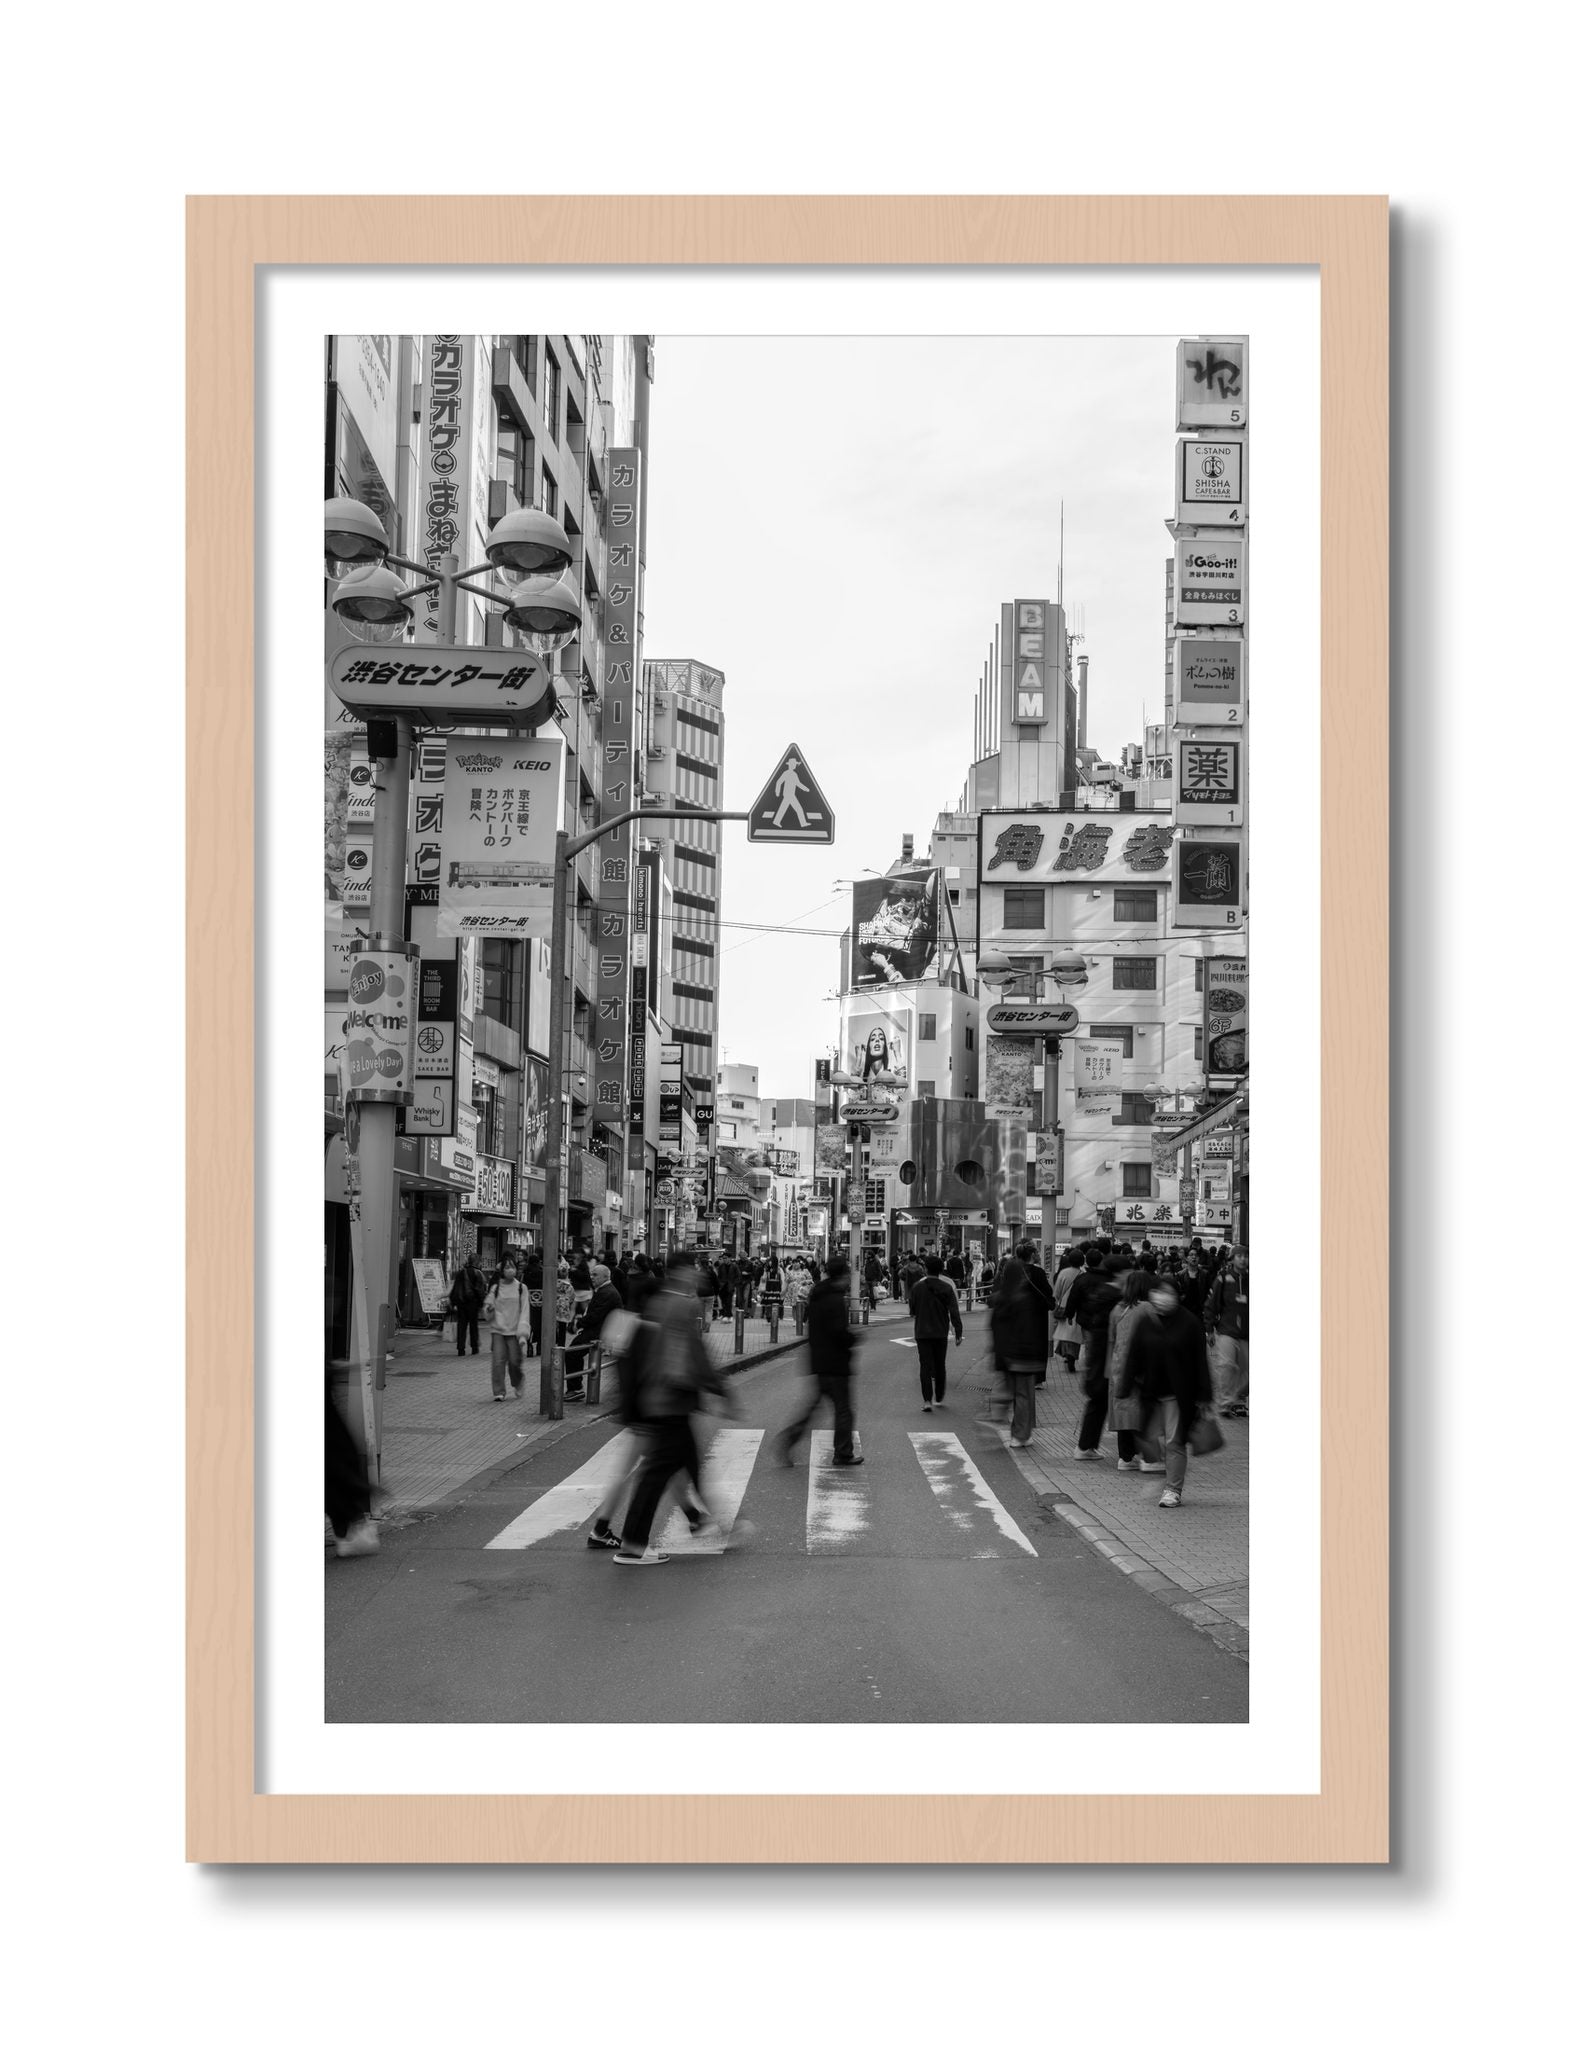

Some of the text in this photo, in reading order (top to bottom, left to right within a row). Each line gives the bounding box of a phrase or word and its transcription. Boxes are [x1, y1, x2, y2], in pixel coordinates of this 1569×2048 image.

[429, 342, 463, 452] カラオケ
[1230, 410, 1239, 422] 5
[1195, 480, 1231, 488] SHISHA
[1229, 509, 1240, 522] 4
[1185, 591, 1238, 601] 全身もみほぐし
[1228, 609, 1238, 622] 3
[1018, 603, 1045, 718] BEAM
[341, 661, 536, 690] 渋谷センター街
[1227, 709, 1237, 721] 2
[513, 760, 552, 771] KEIO
[1188, 747, 1228, 787] 薬
[483, 788, 499, 847] カントーの
[516, 789, 531, 837] 京王線で
[1227, 810, 1235, 823] 1
[988, 822, 1174, 871] 角海老
[637, 870, 645, 898] kimono
[459, 916, 530, 927] 渋谷センター街
[1227, 910, 1236, 924] B
[352, 970, 383, 998] Enjoy
[347, 1010, 408, 1030] Welcome
[993, 1012, 1073, 1022] 渋谷センター街
[1209, 1018, 1232, 1034] 6F
[361, 1056, 386, 1073] Lovely
[414, 1107, 440, 1117] Whisky
[697, 1110, 713, 1119] GU
[843, 1107, 892, 1116] 渋谷センター街
